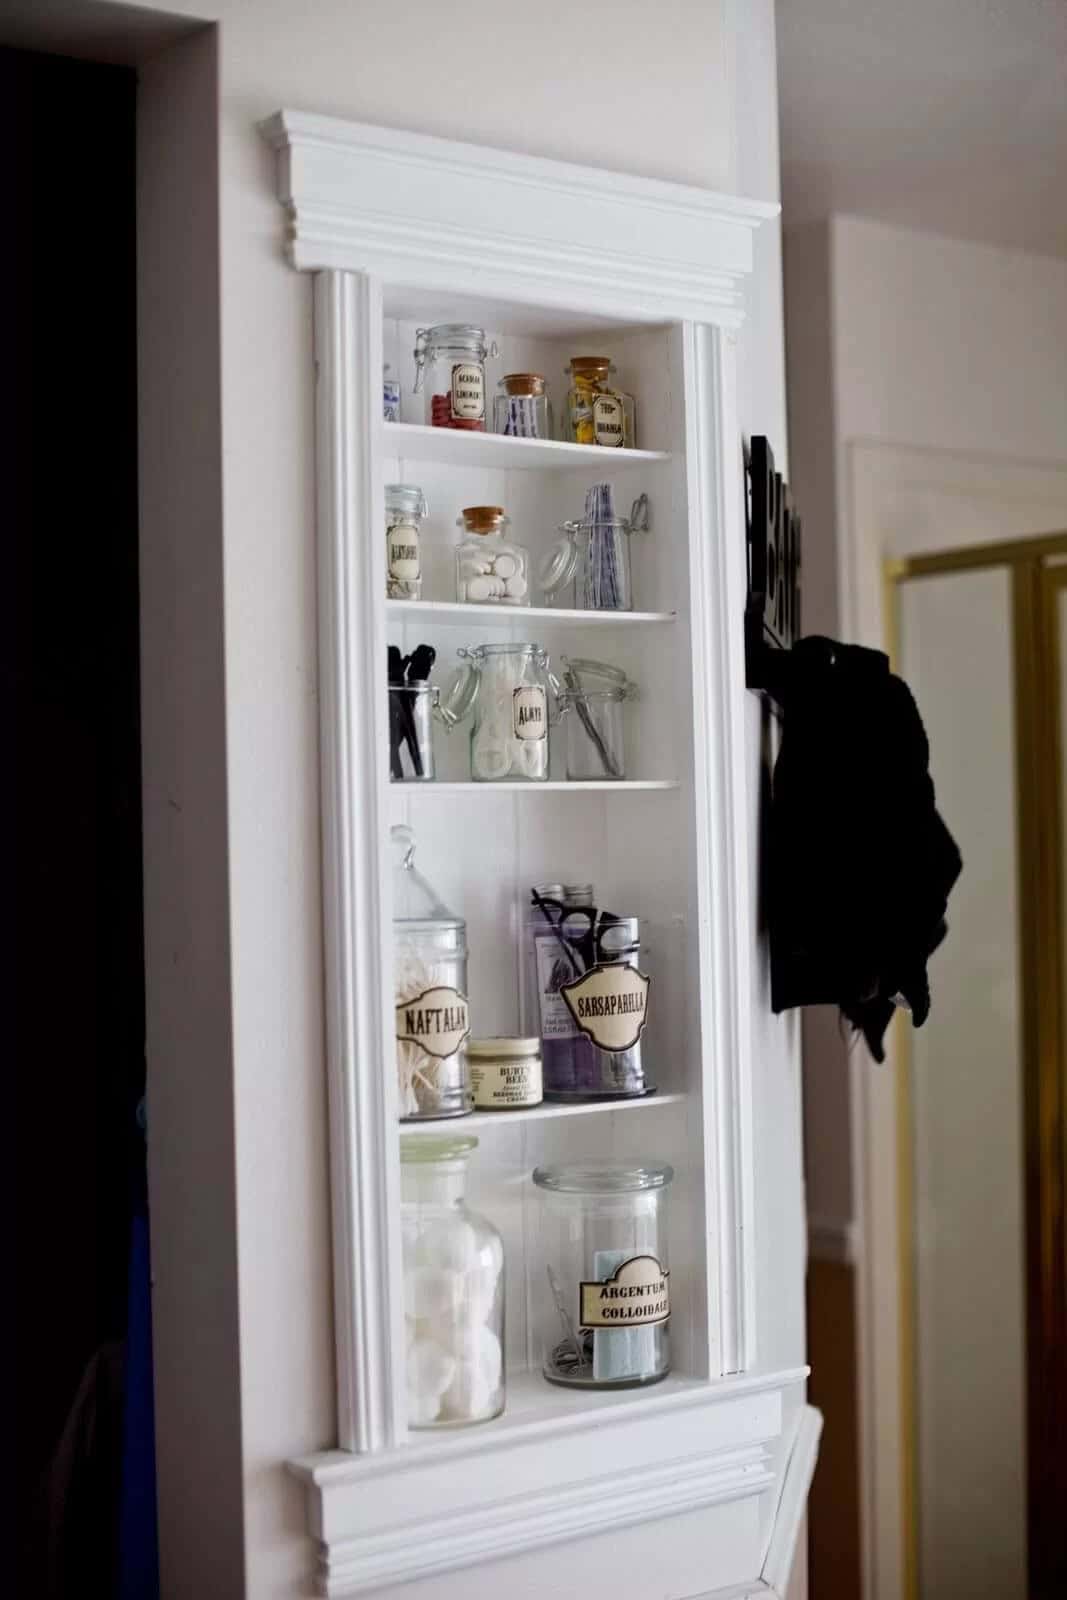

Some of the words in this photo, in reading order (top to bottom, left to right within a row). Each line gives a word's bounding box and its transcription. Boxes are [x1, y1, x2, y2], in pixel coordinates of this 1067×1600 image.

[578, 992, 644, 1017] SARSAPARILLA
[405, 1006, 466, 1035] NAFTALAN
[600, 1282, 664, 1299] ARGENTUM
